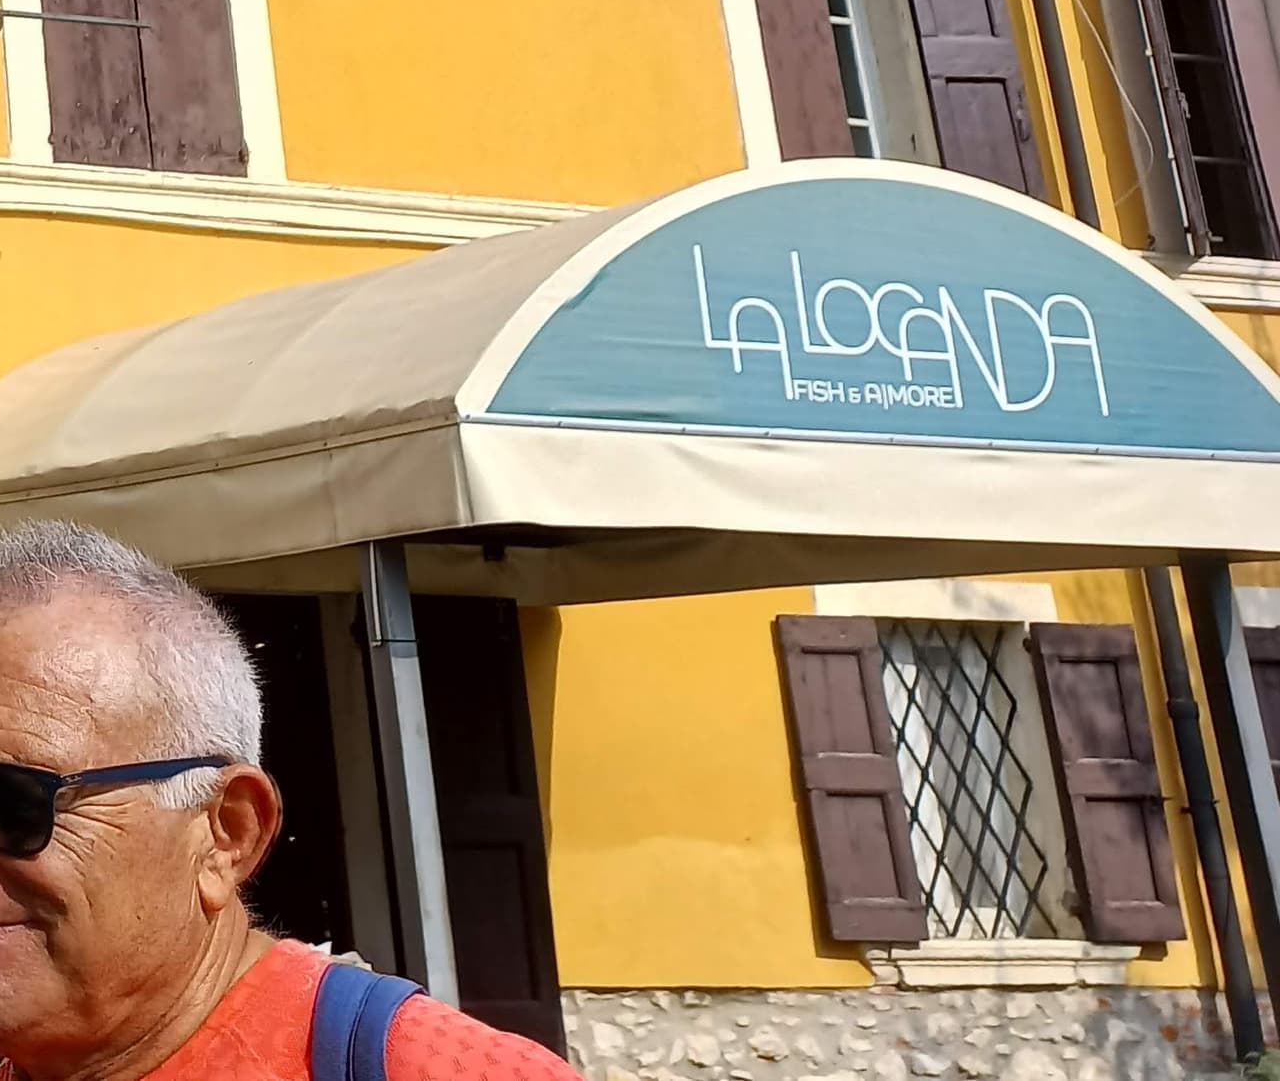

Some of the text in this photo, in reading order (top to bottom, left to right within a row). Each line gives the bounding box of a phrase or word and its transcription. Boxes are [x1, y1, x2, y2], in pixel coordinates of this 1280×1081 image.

[693, 244, 1109, 417] LA LOCANDA
[792, 379, 845, 402] FISH
[848, 386, 861, 404] &
